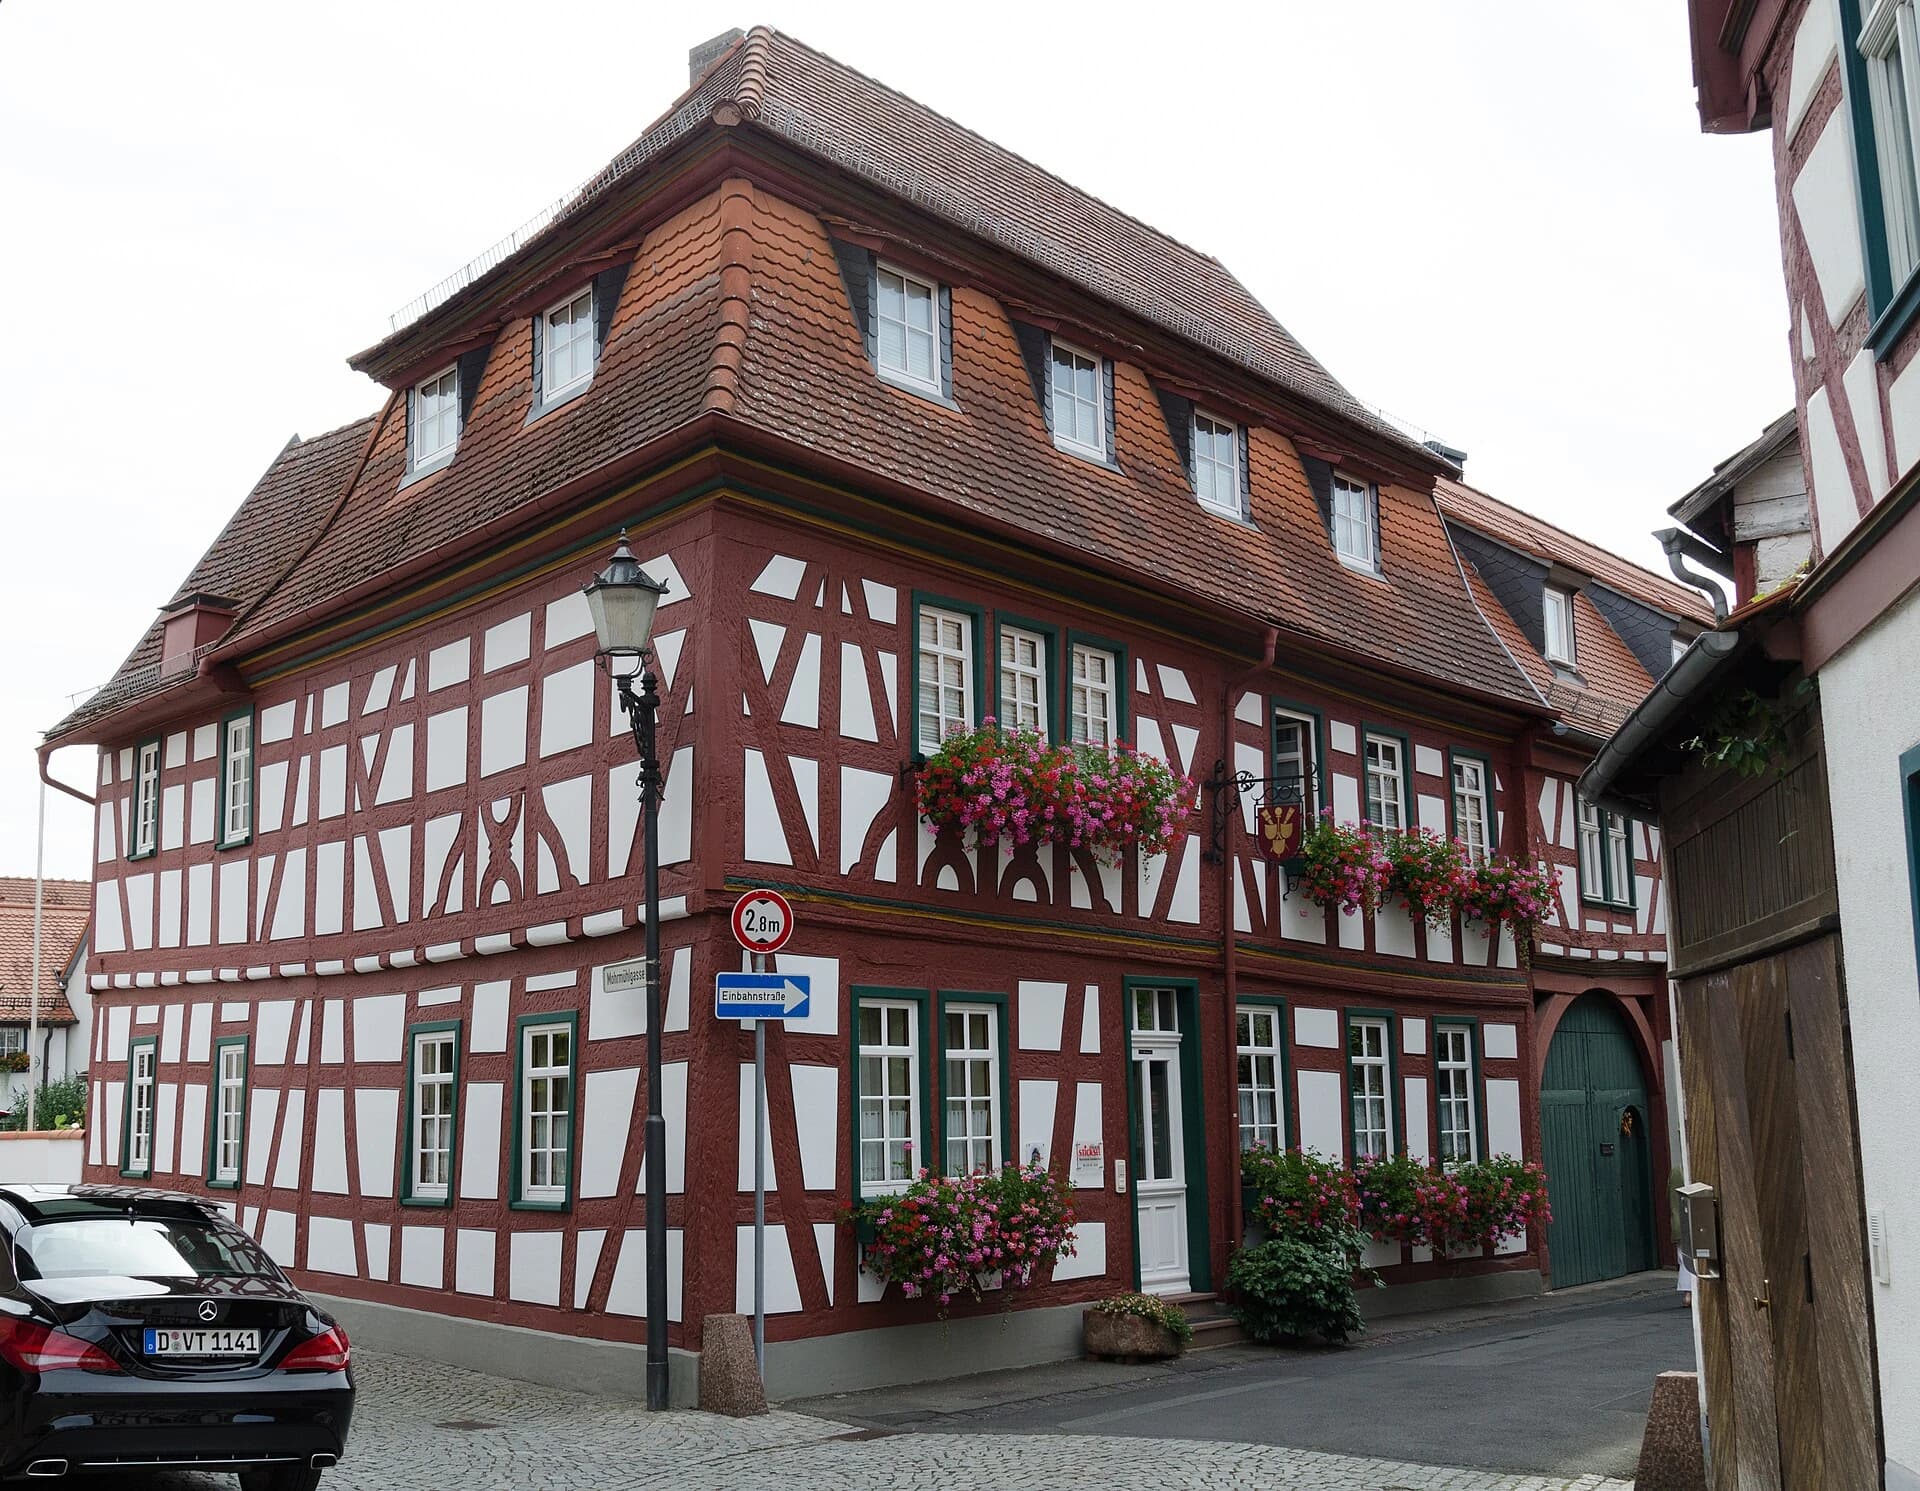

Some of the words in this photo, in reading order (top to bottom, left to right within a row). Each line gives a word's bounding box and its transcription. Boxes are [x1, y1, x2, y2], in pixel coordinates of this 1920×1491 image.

[722, 990, 786, 1001] Einbahnstraße
[157, 1332, 170, 1351] D
[182, 1332, 207, 1351] VT
[211, 1332, 257, 1351] 1141
